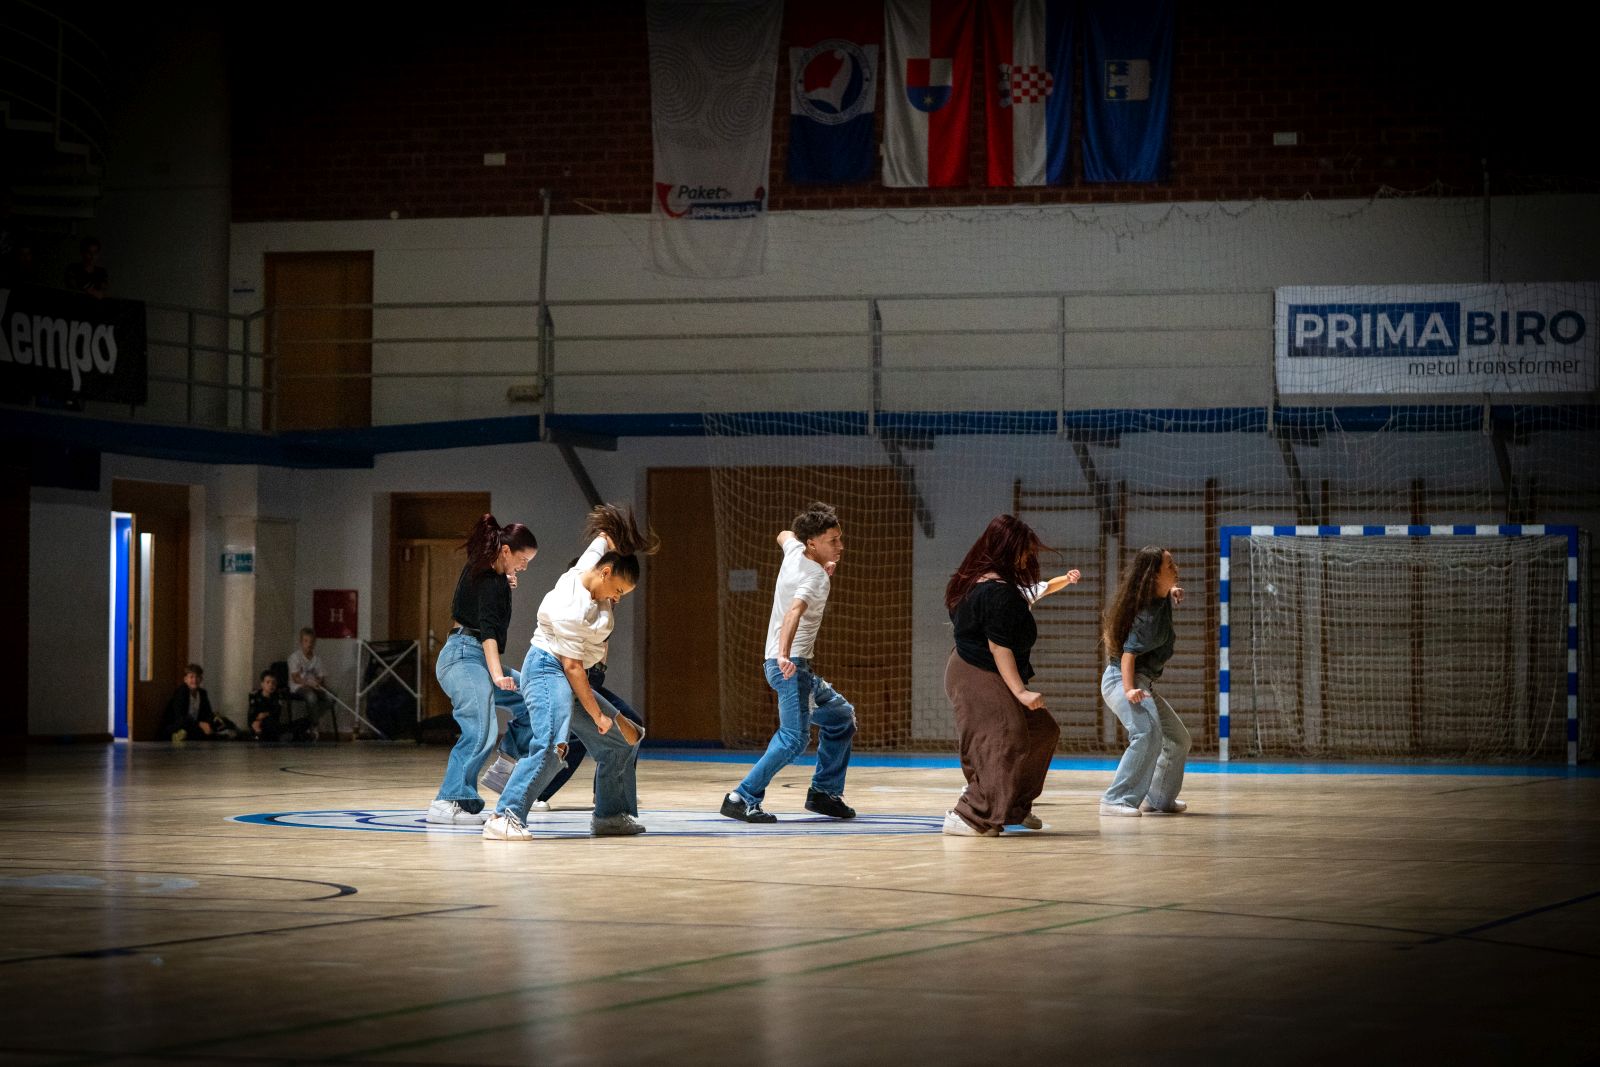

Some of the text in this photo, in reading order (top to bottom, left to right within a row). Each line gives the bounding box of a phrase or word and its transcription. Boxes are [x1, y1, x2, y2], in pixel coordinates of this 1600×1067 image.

[1294, 310, 1587, 350] PRIMA BIRO
[1408, 356, 1581, 377] metal transformer
[328, 608, 345, 623] H
